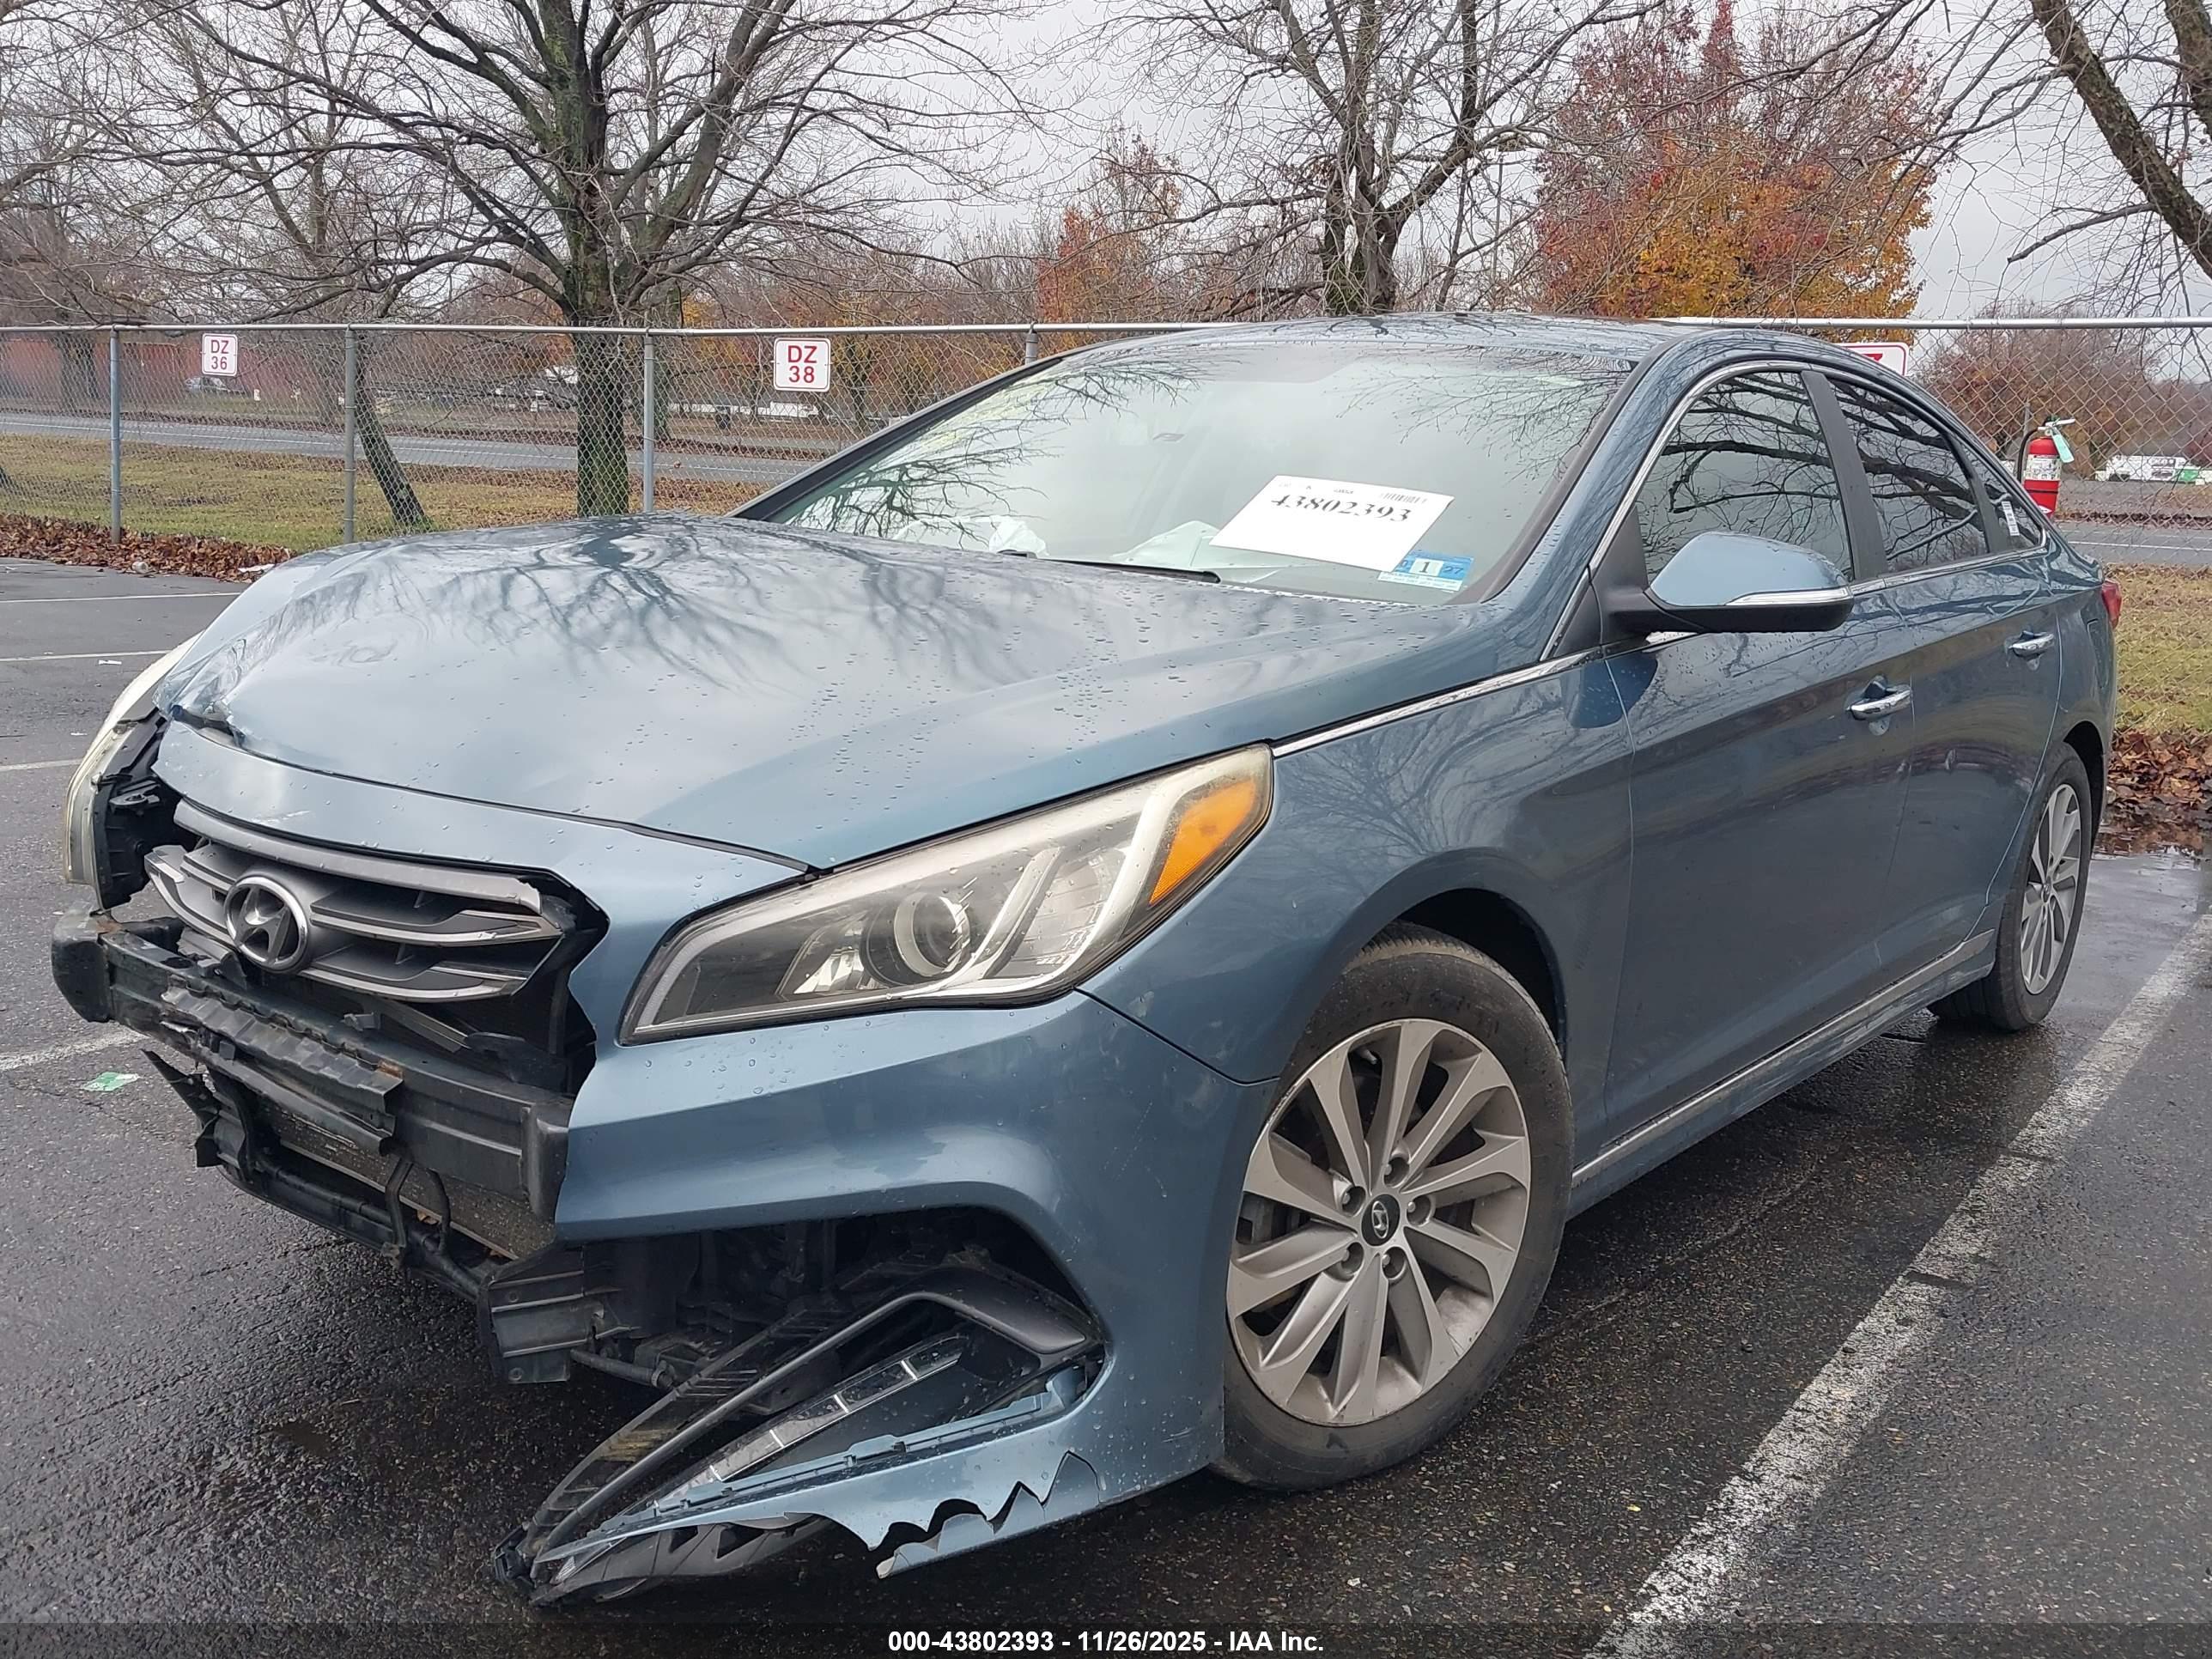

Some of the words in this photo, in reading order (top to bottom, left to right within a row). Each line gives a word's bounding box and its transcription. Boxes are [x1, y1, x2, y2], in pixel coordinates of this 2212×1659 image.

[210, 339, 229, 354] DZ
[787, 345, 817, 364] DZ
[211, 356, 228, 370] 36
[788, 365, 815, 384] 38
[1271, 494, 1412, 522] 43802393
[1419, 561, 1431, 574] 1
